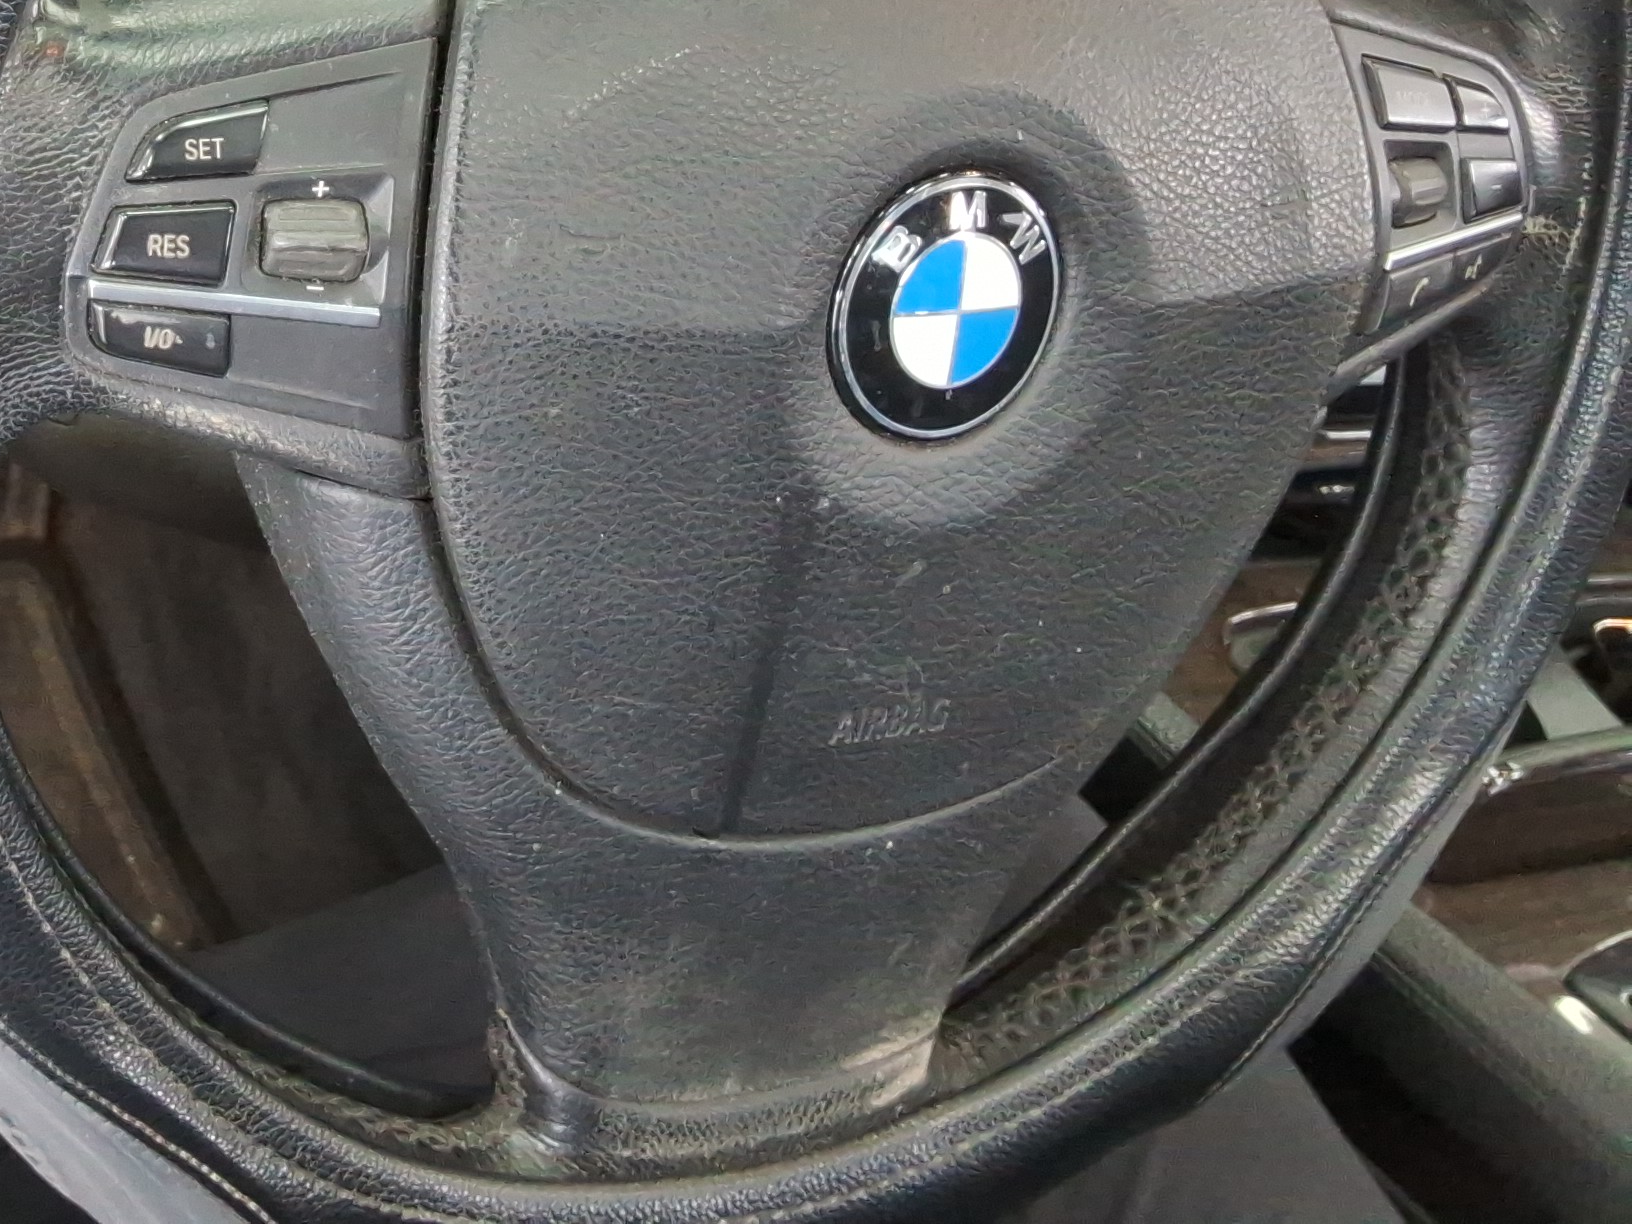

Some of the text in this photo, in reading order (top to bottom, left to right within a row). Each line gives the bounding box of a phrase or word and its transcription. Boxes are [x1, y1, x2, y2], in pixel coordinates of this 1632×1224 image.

[184, 137, 225, 161] SET
[146, 233, 191, 259] RES
[872, 189, 1048, 272] BMW
[827, 697, 952, 746] AIRBAG
